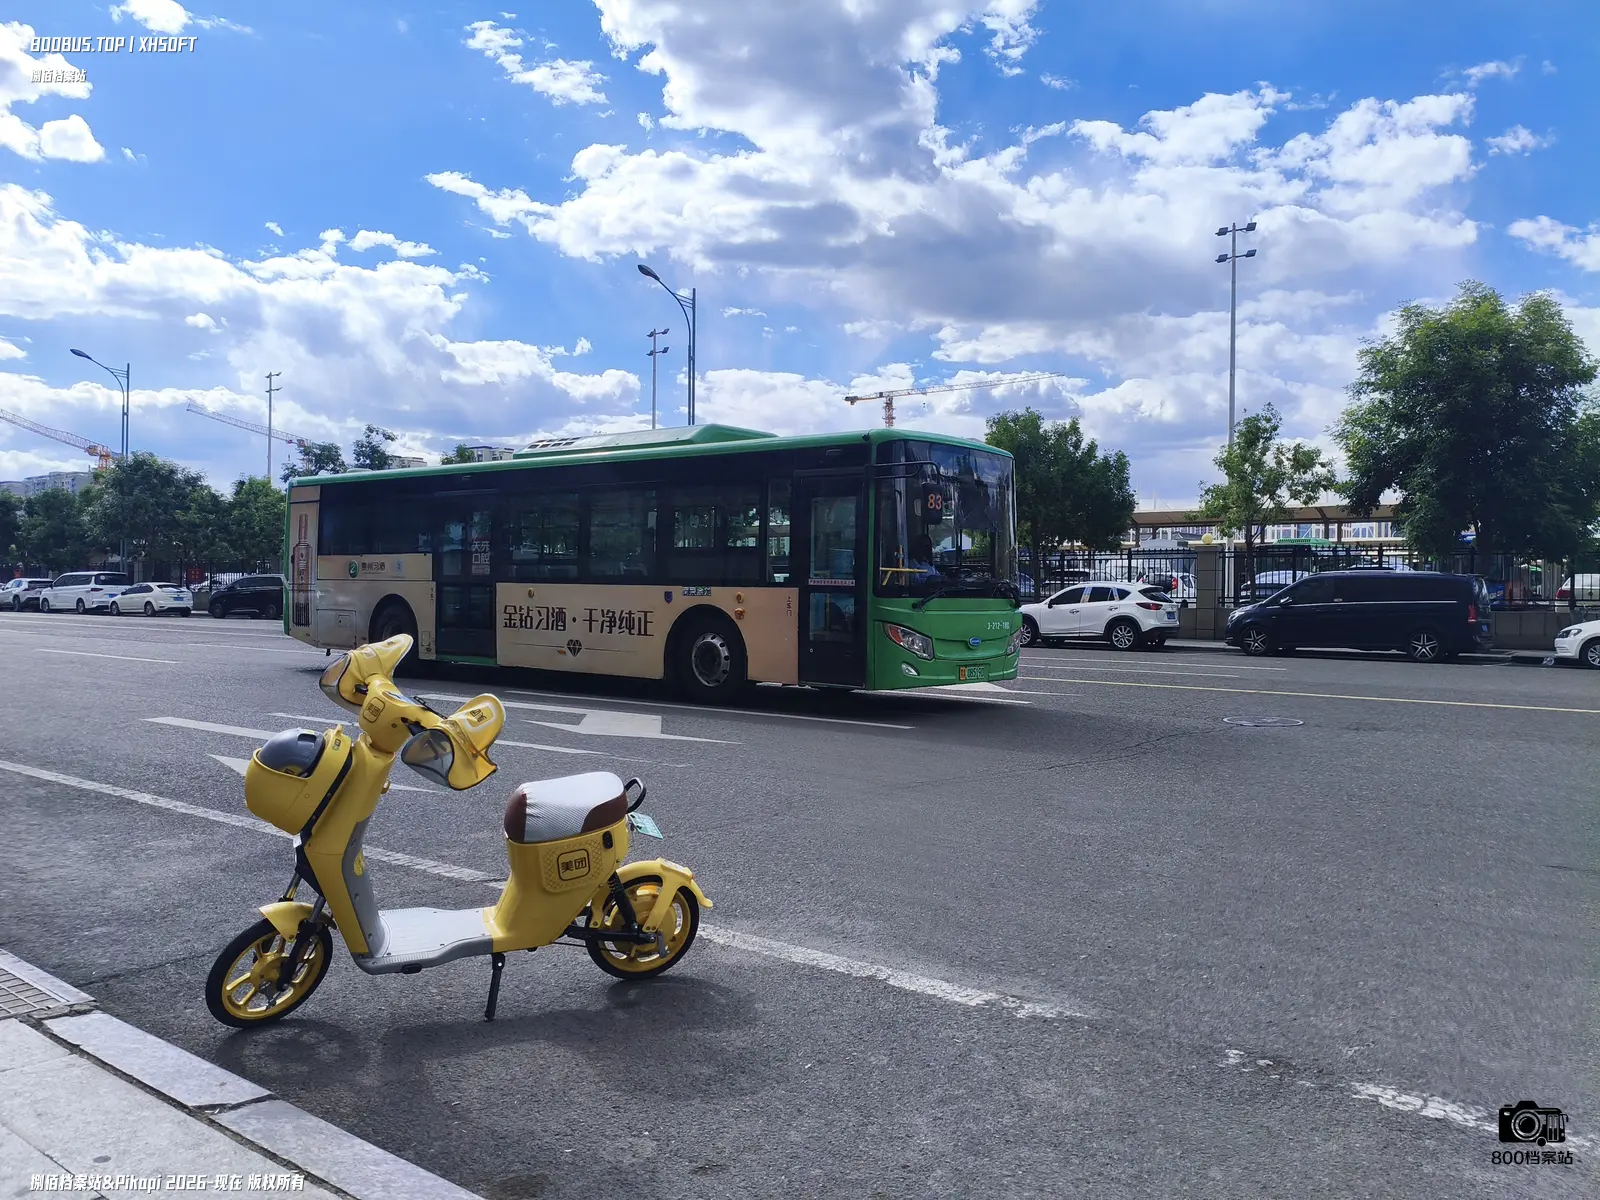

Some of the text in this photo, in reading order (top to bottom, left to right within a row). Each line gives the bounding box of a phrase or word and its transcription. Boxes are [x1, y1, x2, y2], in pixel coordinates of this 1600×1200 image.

[928, 493, 942, 509] 83
[503, 605, 654, 636] 金钻习酒·干净纯正
[561, 857, 587, 873] 美团
